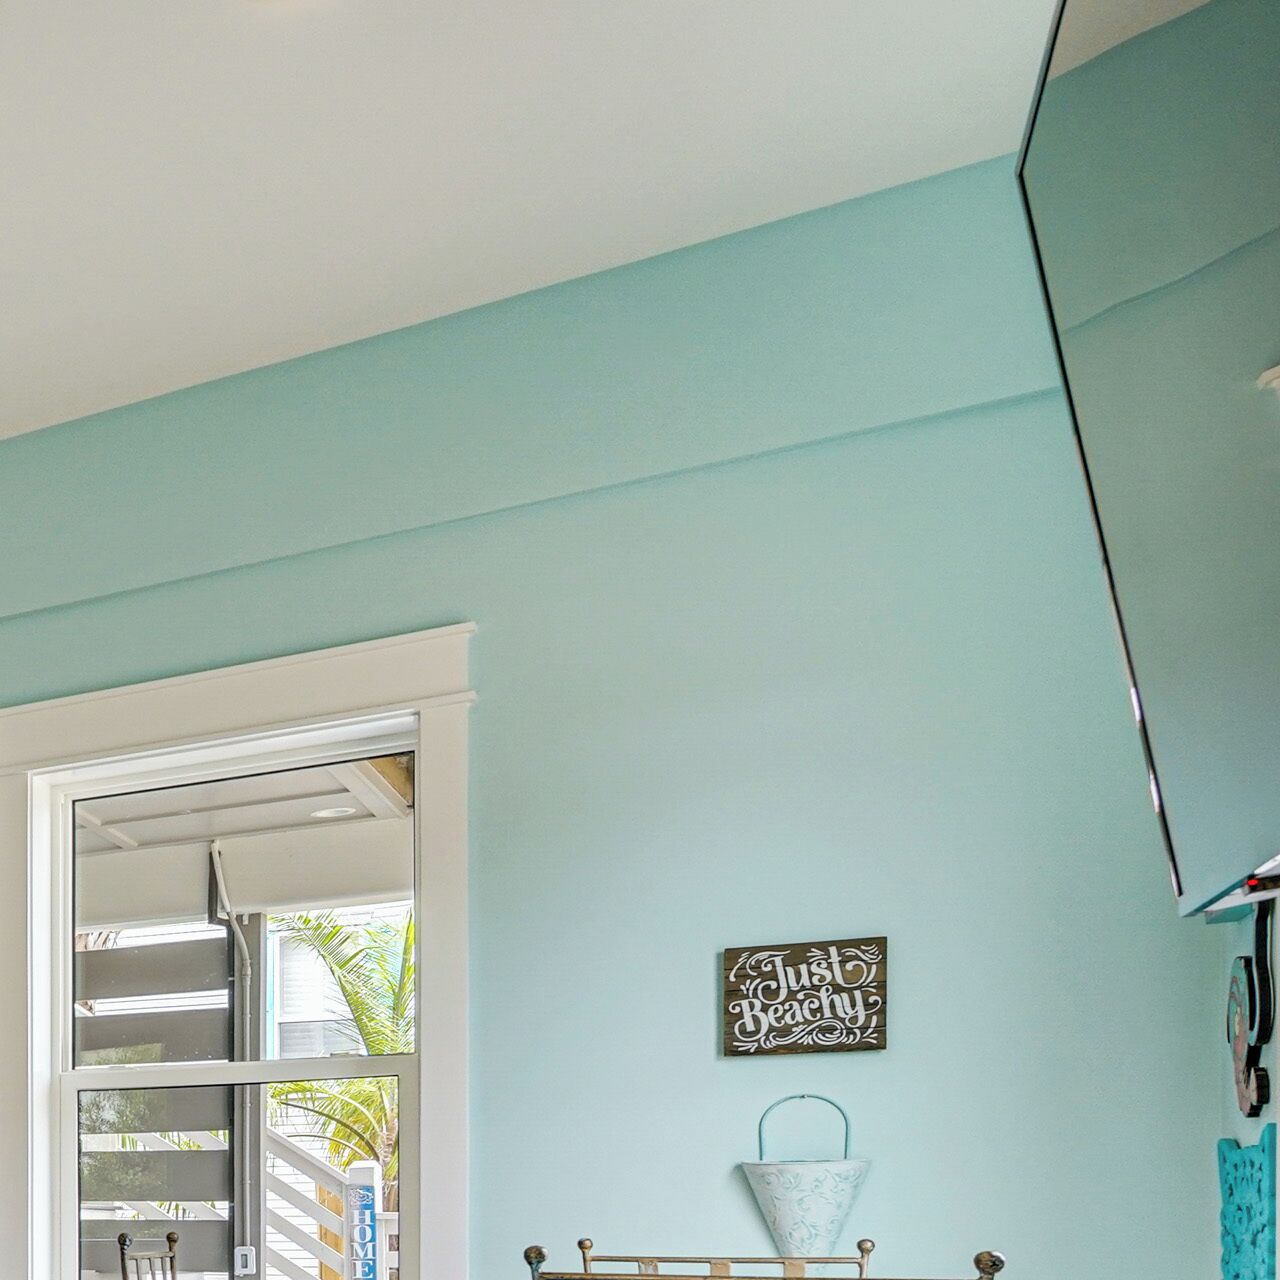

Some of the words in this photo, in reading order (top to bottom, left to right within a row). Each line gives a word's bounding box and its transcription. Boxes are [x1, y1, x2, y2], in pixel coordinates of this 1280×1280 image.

[747, 945, 867, 1003] Just
[728, 985, 882, 1041] Beachy
[352, 1209, 377, 1279] HOME
